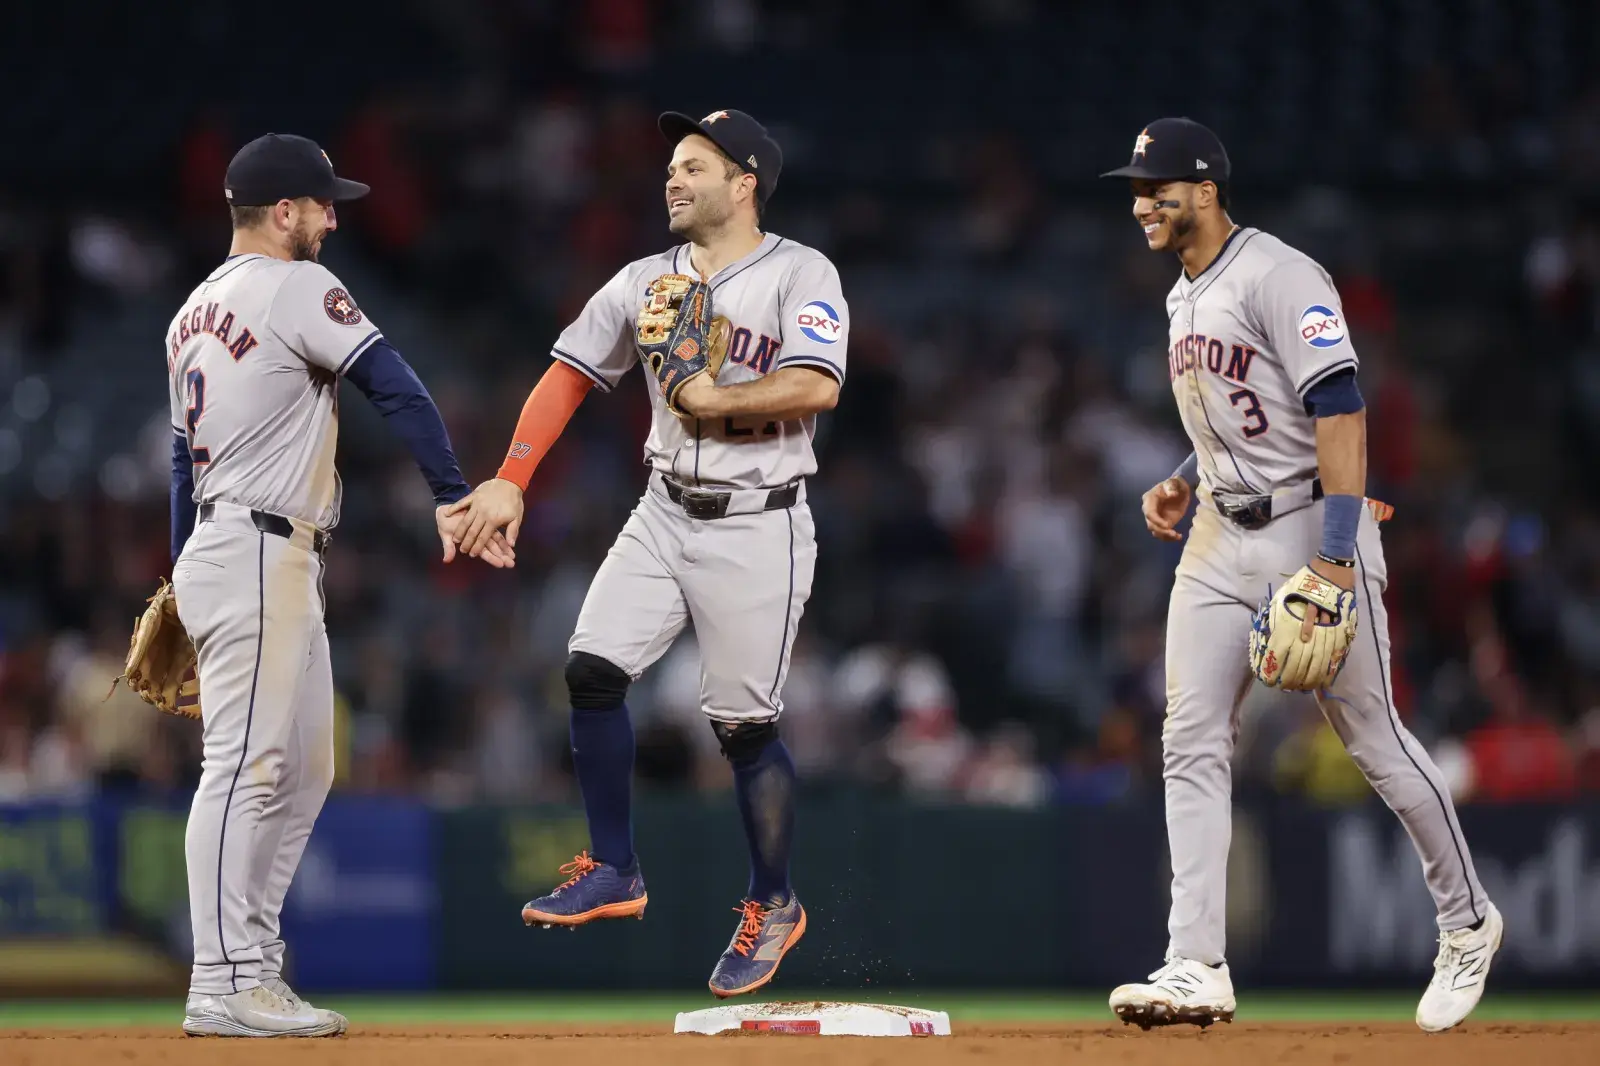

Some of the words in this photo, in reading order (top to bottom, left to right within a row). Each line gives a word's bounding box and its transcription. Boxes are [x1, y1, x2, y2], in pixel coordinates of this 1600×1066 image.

[798, 314, 841, 333] OXY
[1301, 318, 1340, 340] OXY
[185, 365, 211, 465] 2
[1228, 389, 1270, 438] 3
[510, 442, 532, 459] 27
